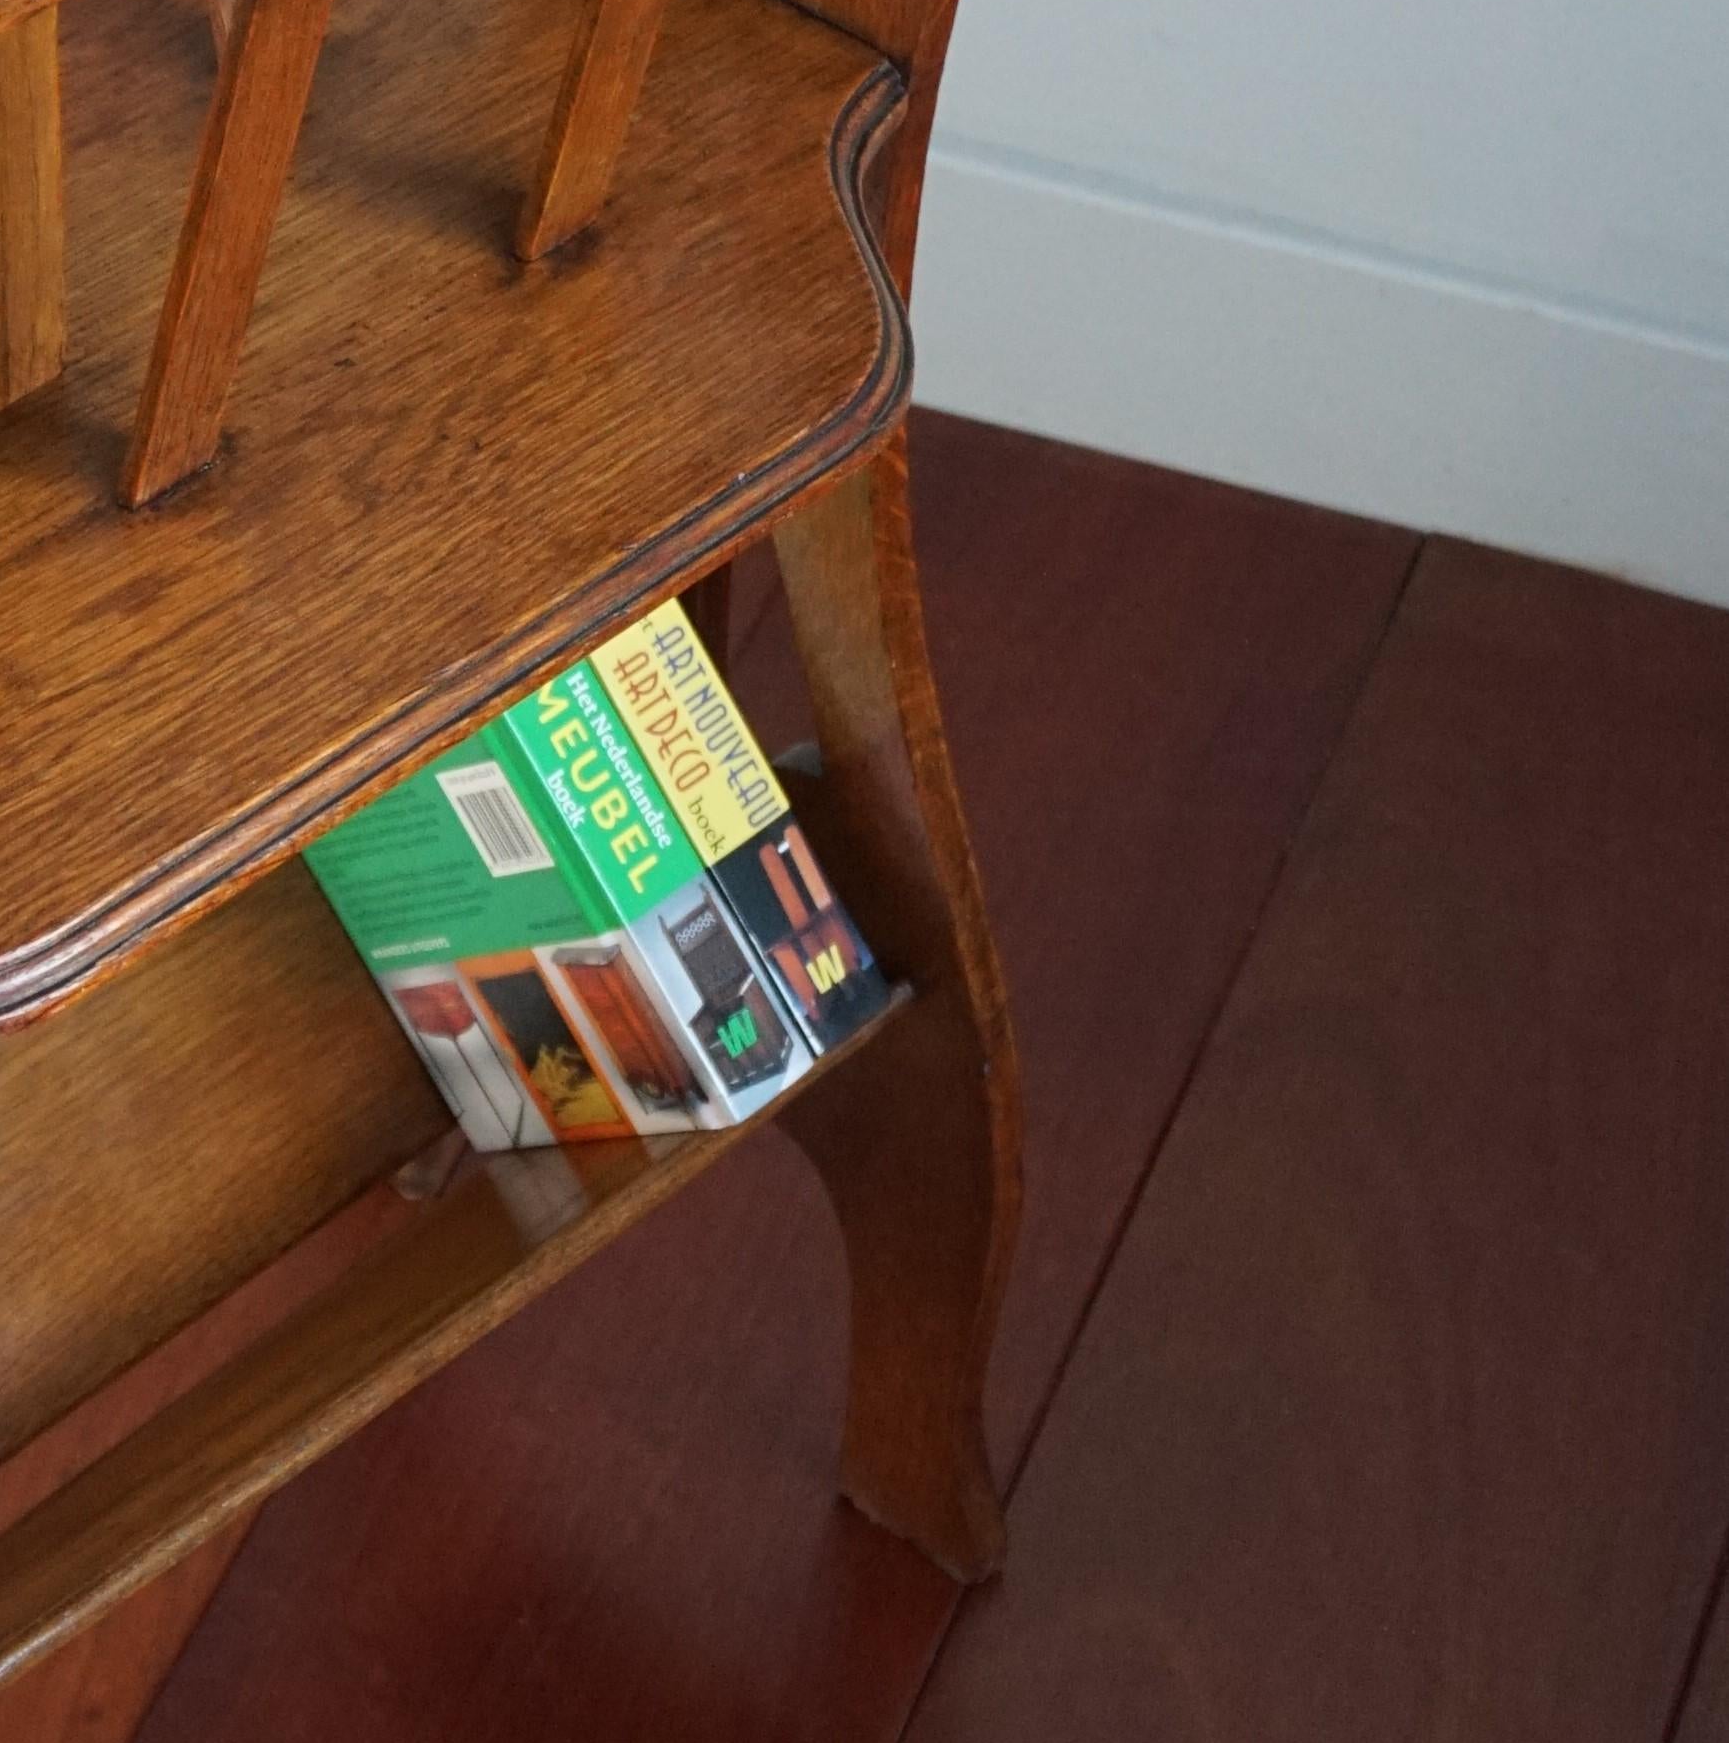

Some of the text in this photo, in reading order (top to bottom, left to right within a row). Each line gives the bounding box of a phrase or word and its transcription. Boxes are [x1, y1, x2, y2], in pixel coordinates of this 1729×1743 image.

[537, 680, 659, 894] MEUBEL
[546, 768, 586, 830] boek
[566, 671, 672, 850] Het Nederlandse
[613, 651, 727, 855] ART DECO boek
[652, 625, 706, 690] ART
[683, 682, 782, 830] NOUVEAU
